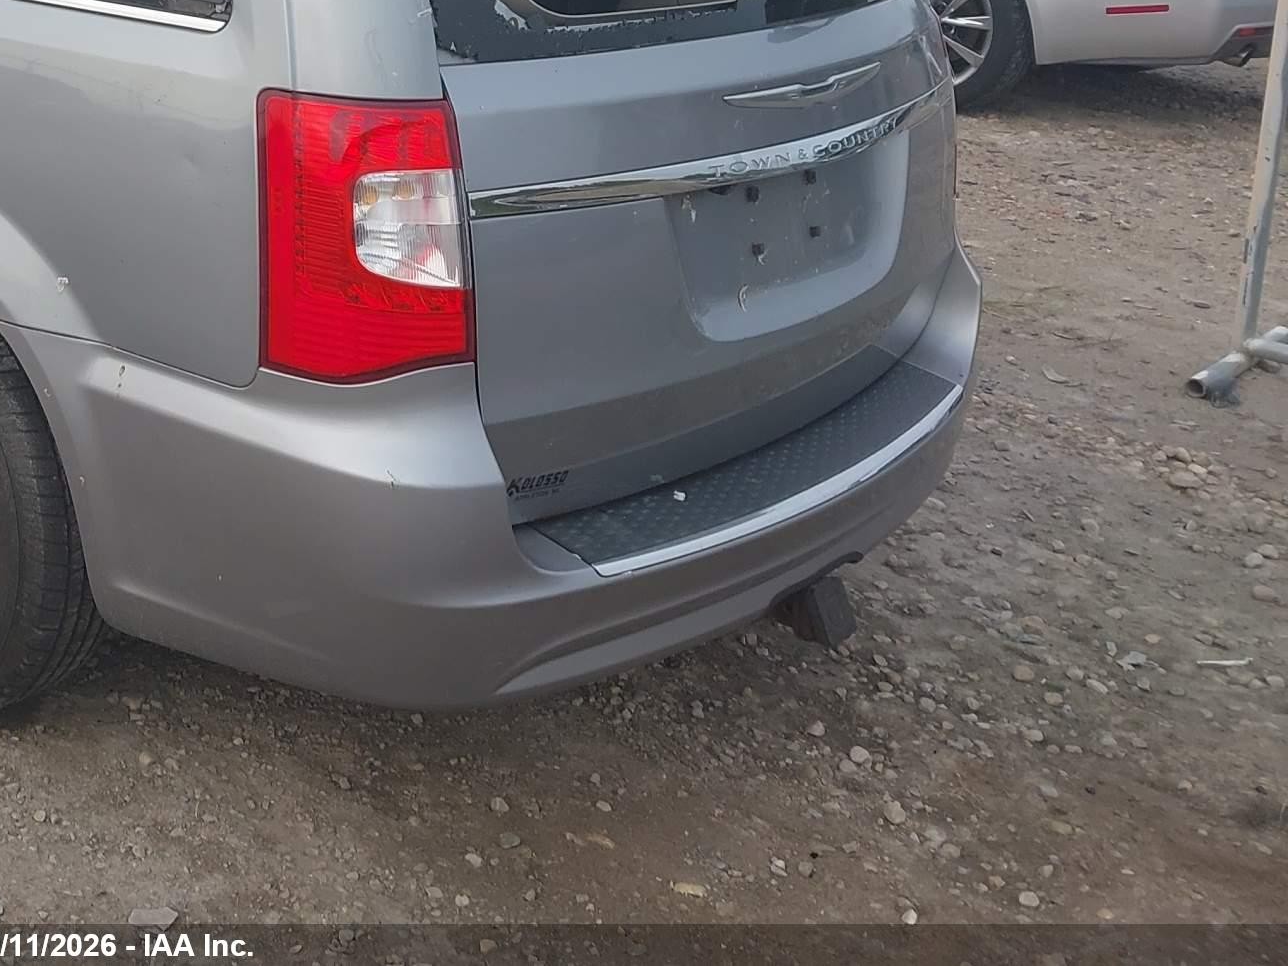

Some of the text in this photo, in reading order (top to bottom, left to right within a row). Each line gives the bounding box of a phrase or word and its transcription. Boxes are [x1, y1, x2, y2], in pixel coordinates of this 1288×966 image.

[709, 117, 897, 177] TOWN & COUNTRY
[506, 470, 569, 496] KOLOSSO
